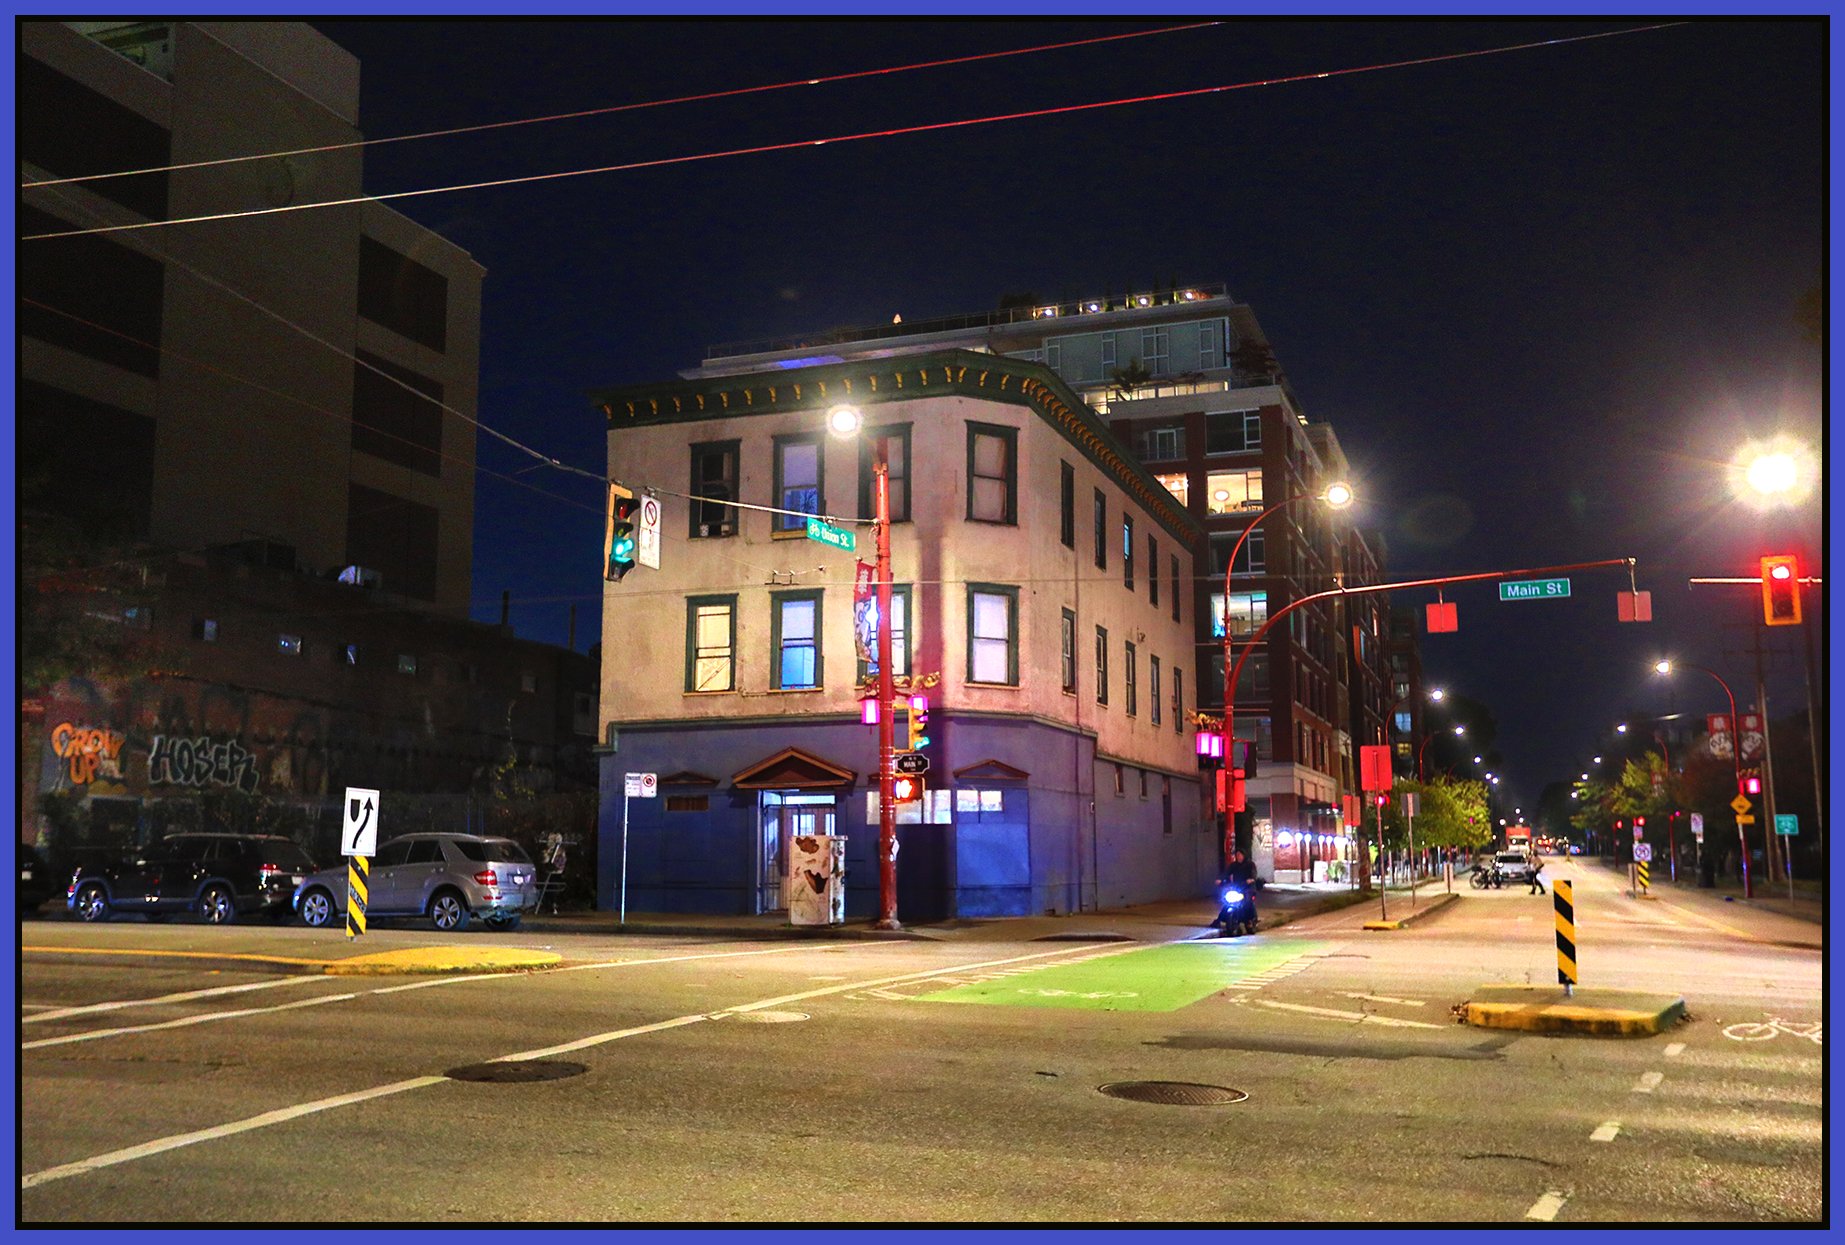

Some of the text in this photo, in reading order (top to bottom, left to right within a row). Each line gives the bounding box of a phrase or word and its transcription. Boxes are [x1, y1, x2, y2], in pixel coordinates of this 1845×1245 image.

[821, 527, 840, 545] Union
[1507, 582, 1562, 597] Main St
[69, 752, 101, 785] UP
[148, 734, 260, 795] HOSER
